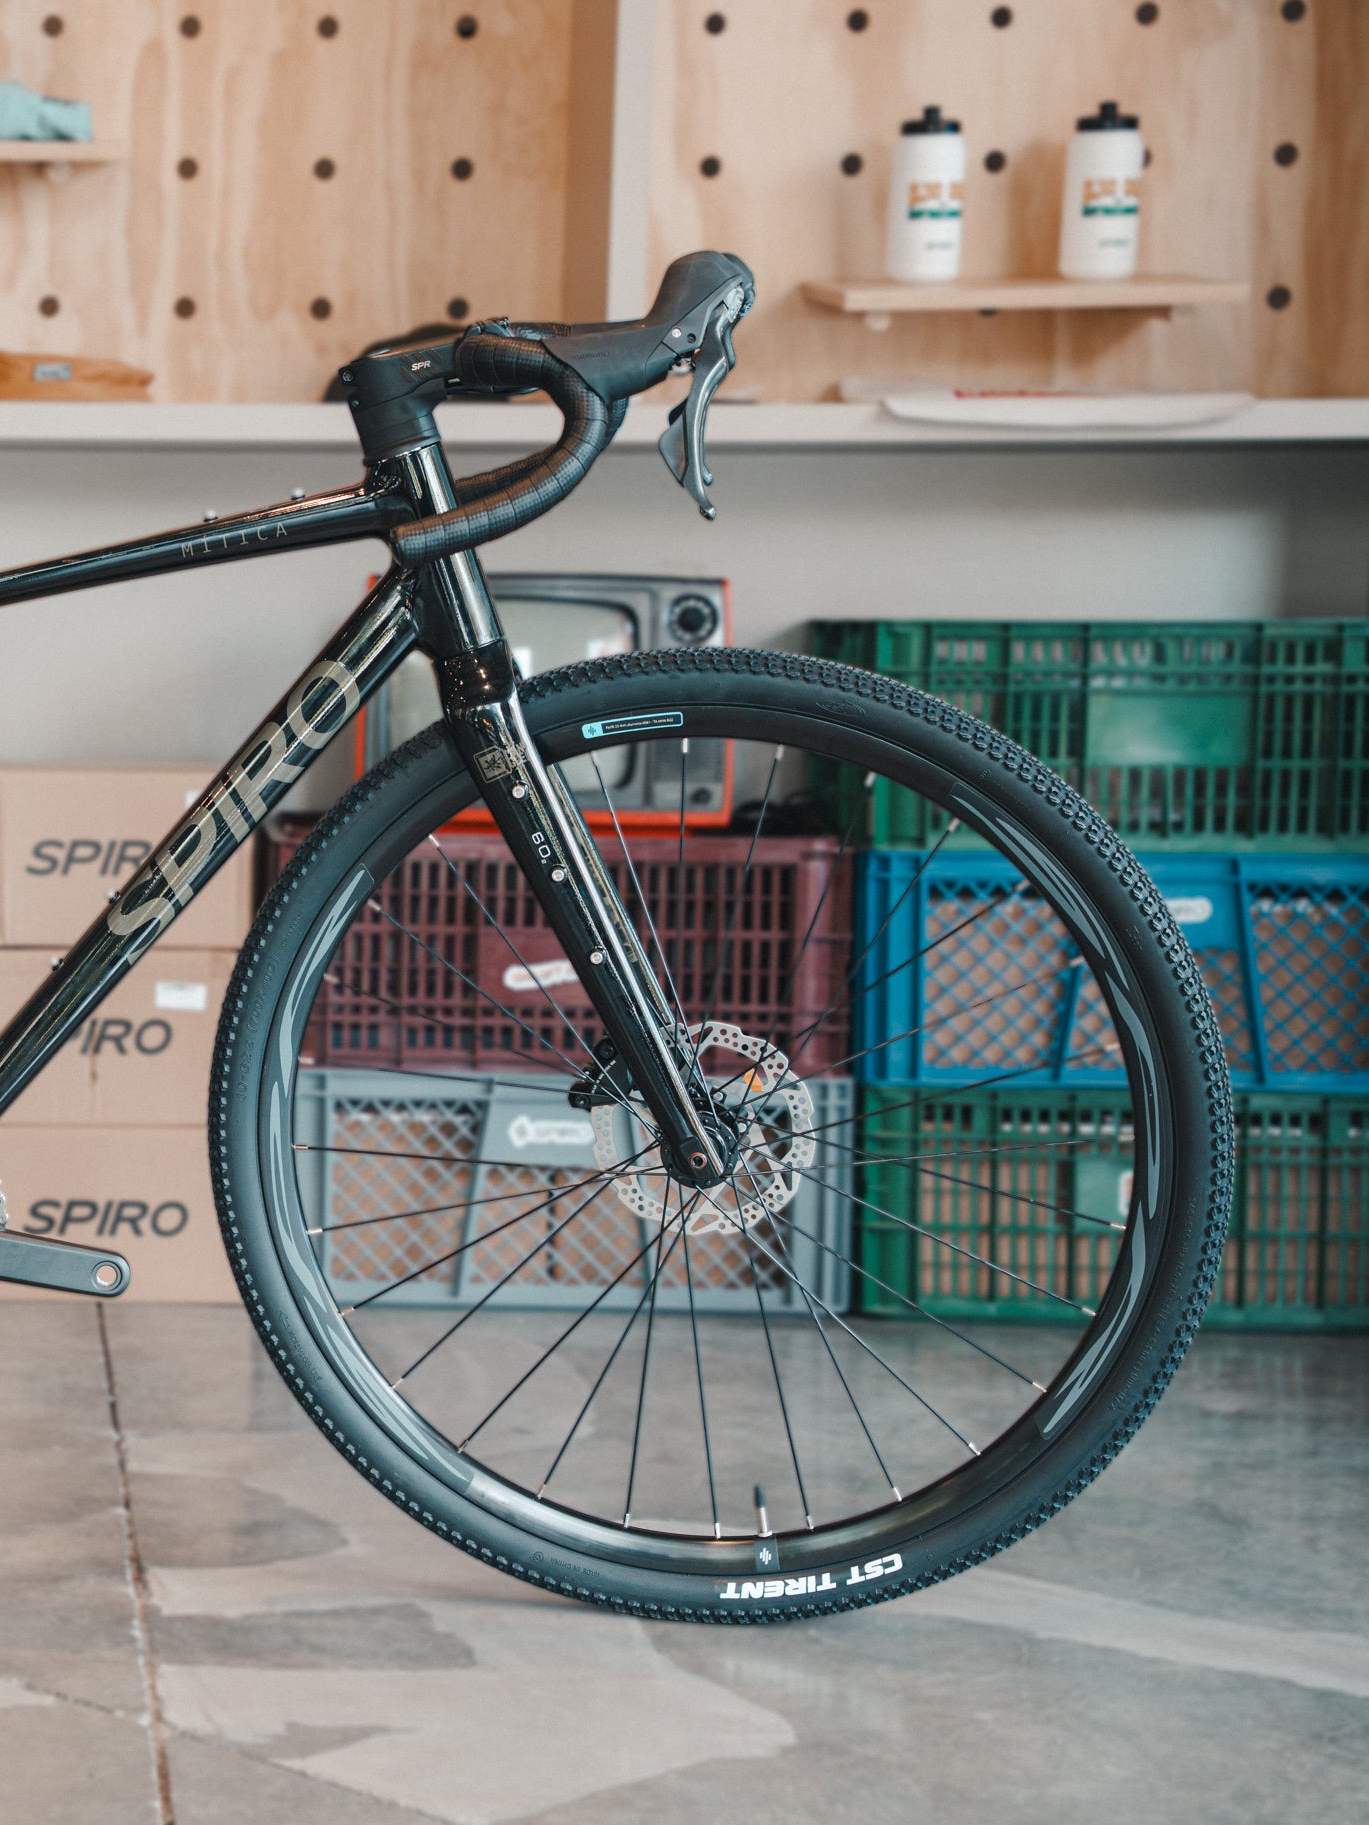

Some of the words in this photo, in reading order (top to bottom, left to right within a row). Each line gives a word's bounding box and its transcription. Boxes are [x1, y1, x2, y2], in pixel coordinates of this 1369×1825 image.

[411, 360, 431, 372] SPR
[107, 660, 361, 967] SPIRO
[26, 840, 154, 877] SPIR
[69, 1018, 172, 1056] IRO
[22, 1199, 188, 1237] SPIRO
[719, 1572, 837, 1599] TIRENT
[846, 1553, 903, 1586] CST
